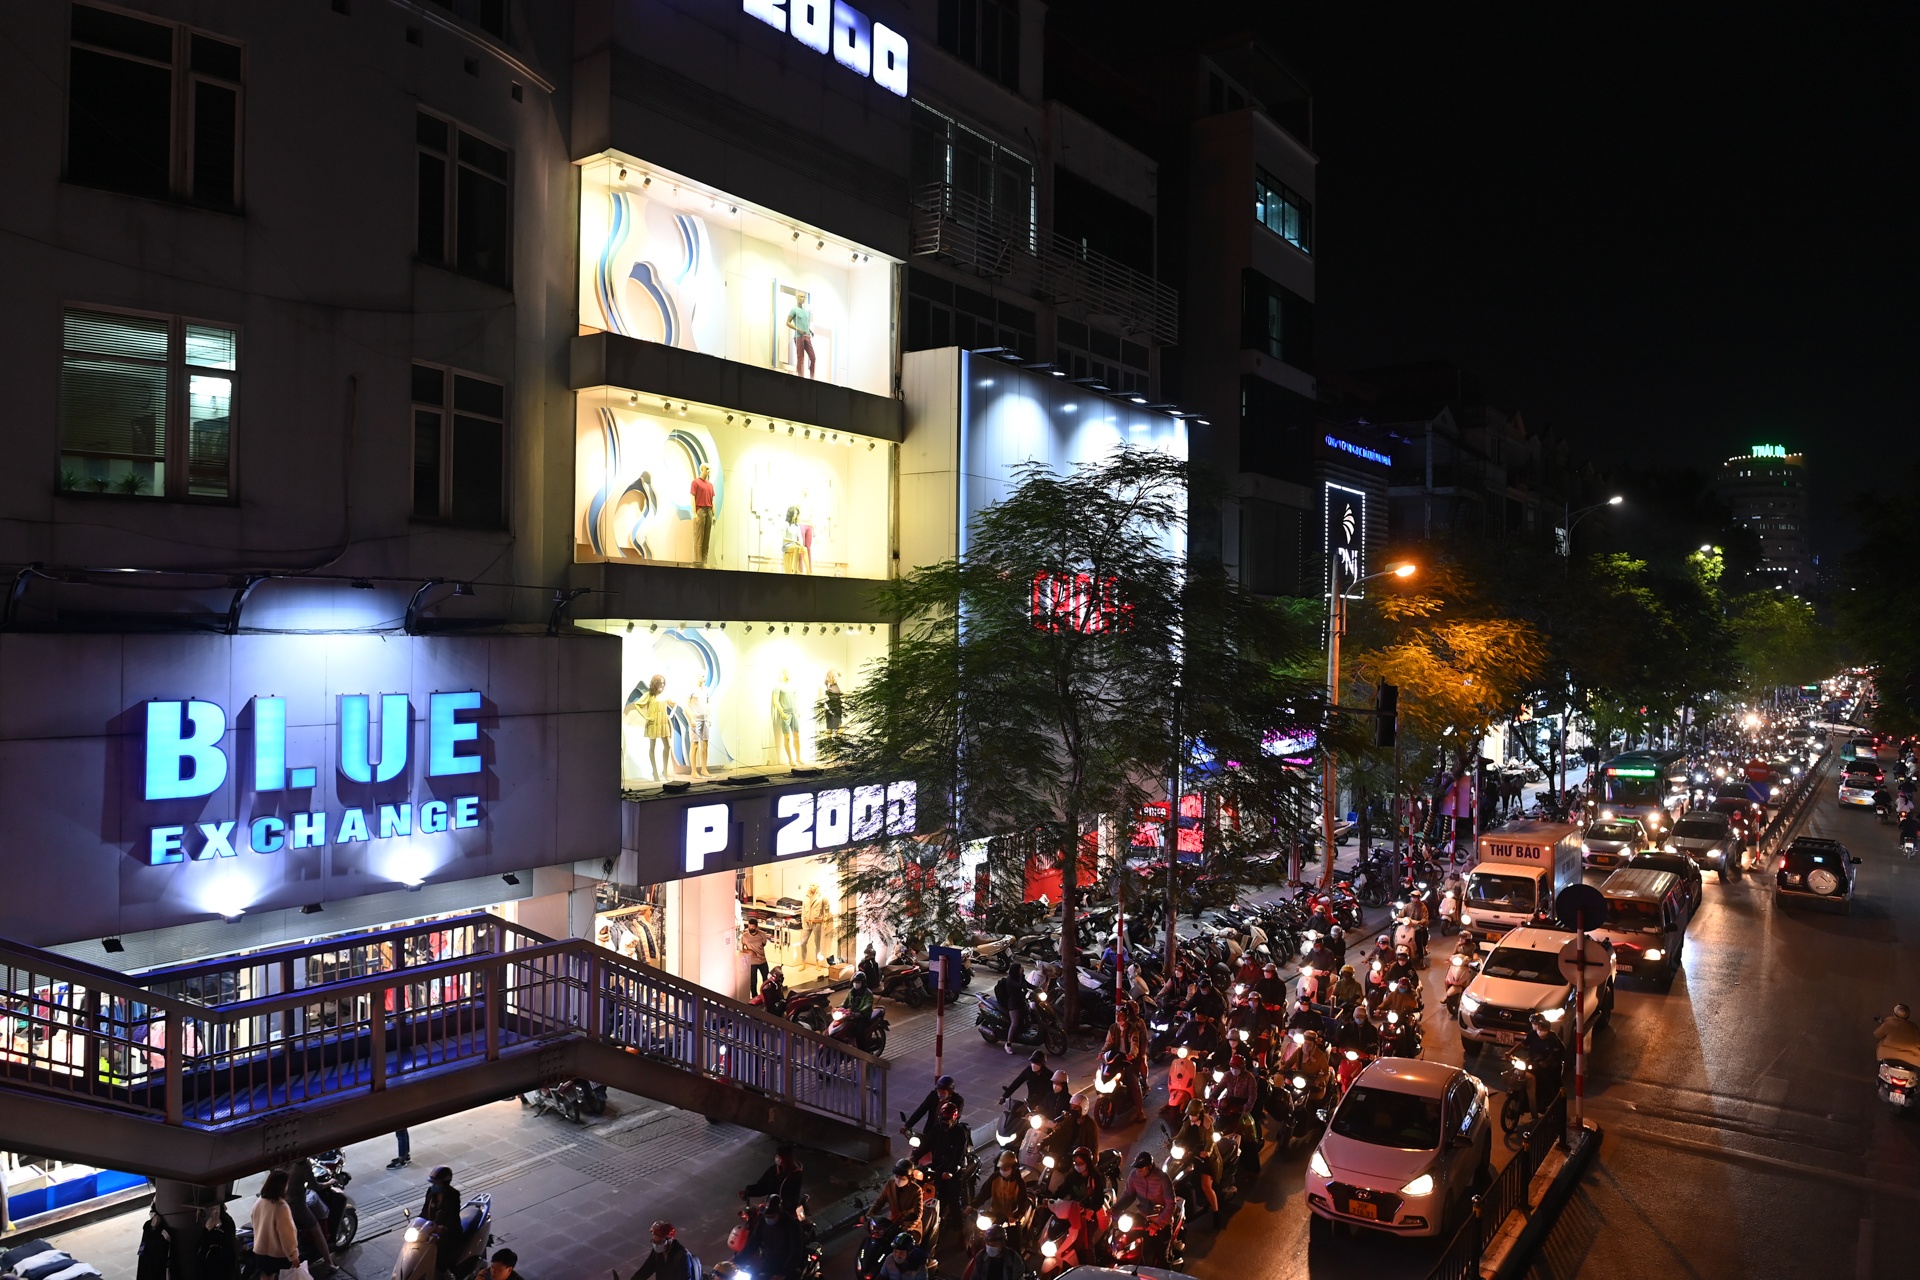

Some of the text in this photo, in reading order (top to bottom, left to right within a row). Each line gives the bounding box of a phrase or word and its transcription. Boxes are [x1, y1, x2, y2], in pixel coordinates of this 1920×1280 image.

[145, 691, 482, 801] BLUE
[150, 796, 480, 866] EXCHANGE
[776, 780, 917, 857] 2000
[1489, 844, 1541, 859] THƯ BÁO
